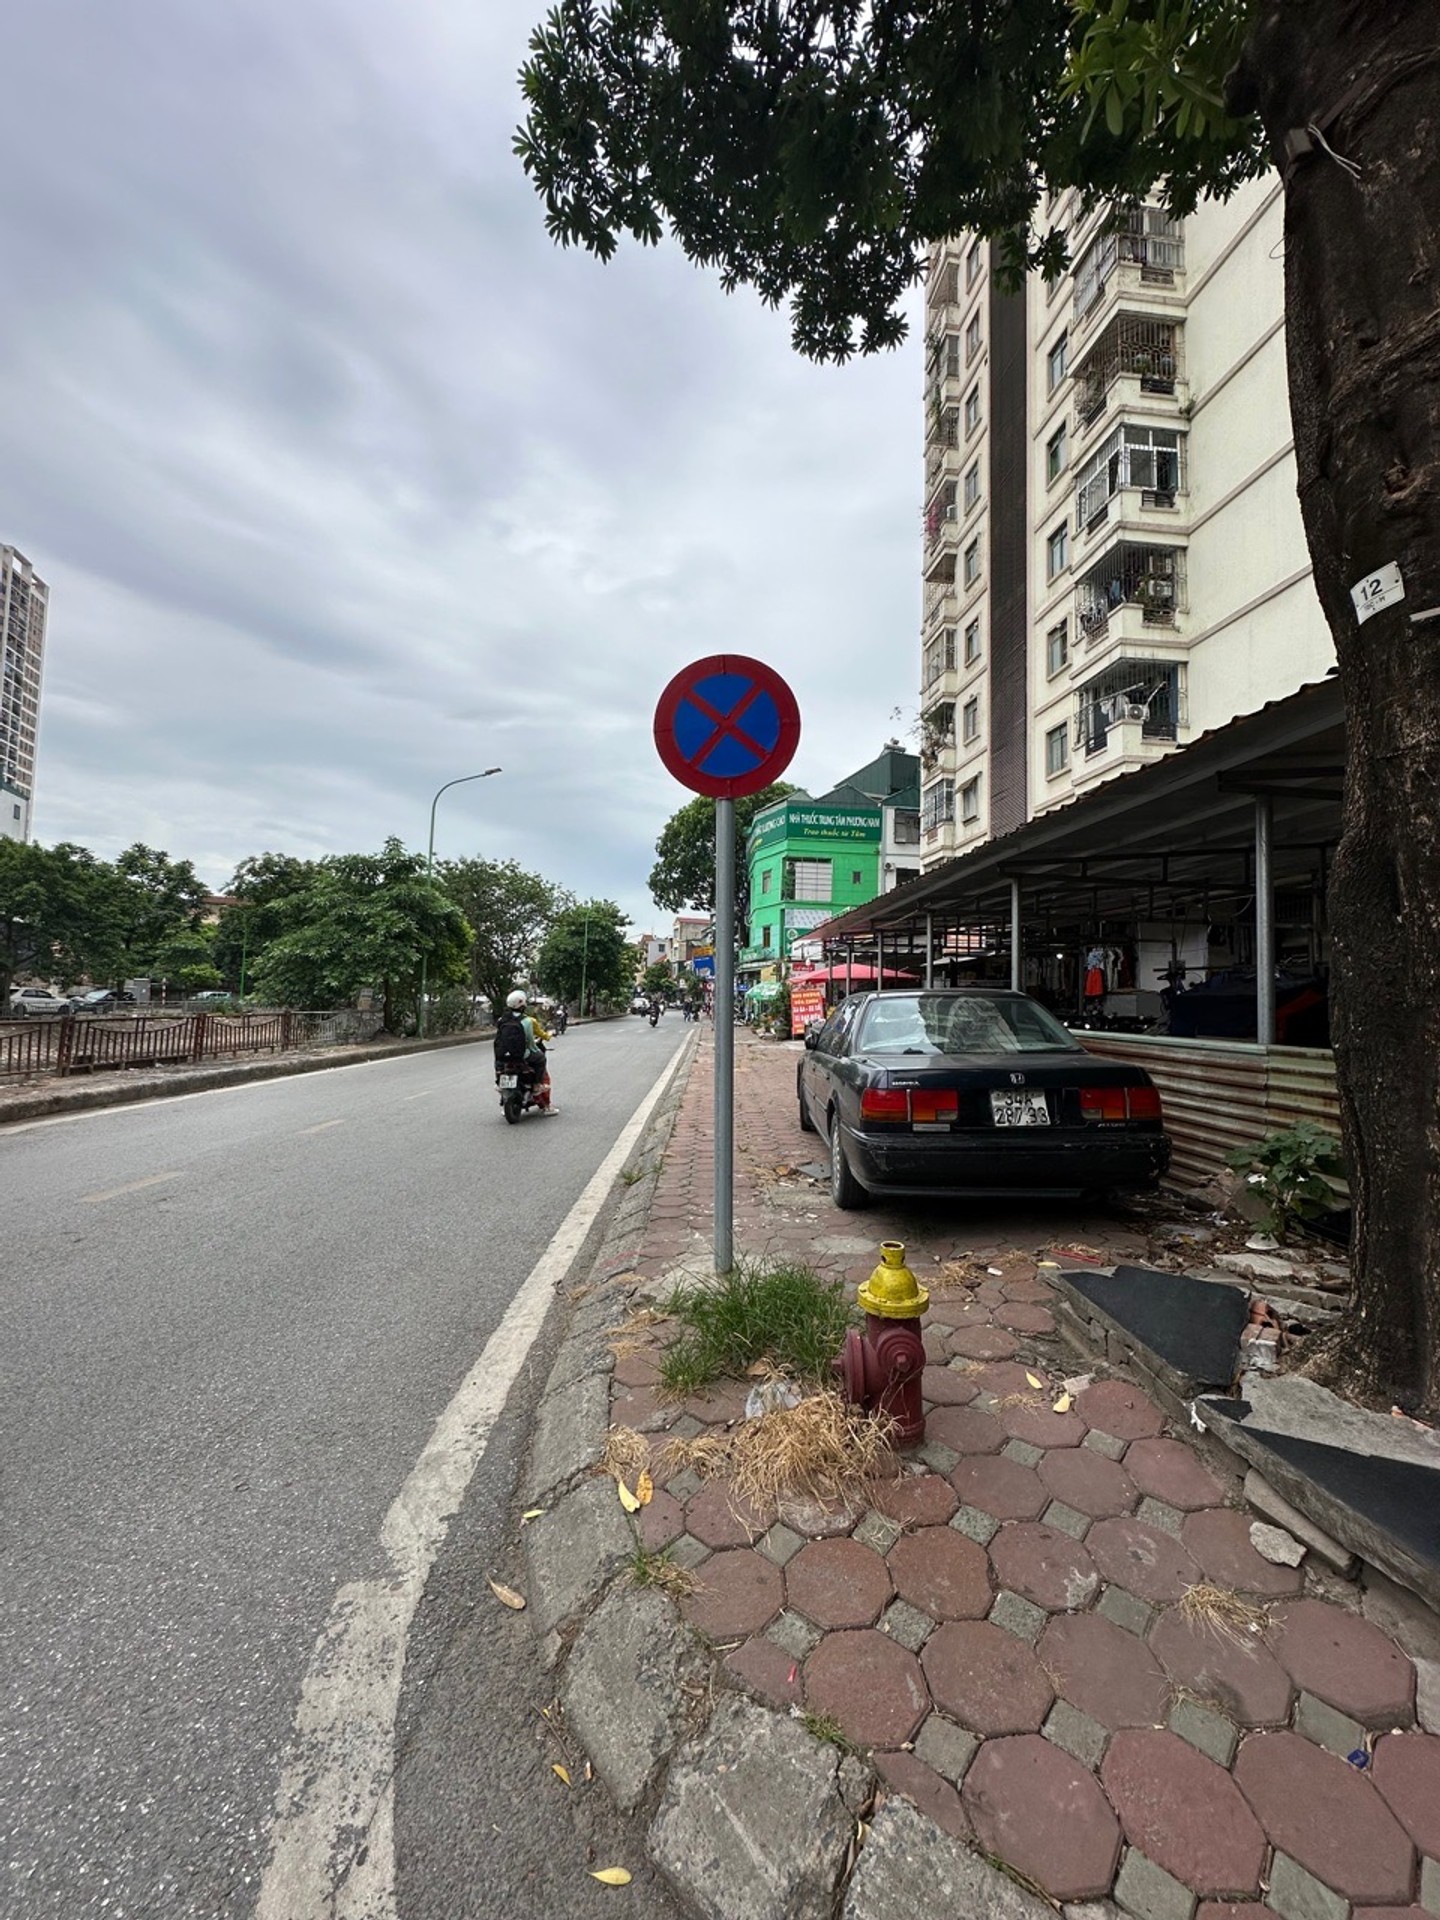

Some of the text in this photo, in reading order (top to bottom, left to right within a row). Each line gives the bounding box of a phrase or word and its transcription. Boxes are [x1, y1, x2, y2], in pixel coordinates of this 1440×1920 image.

[1361, 579, 1383, 601] 12
[789, 812, 800, 824] NHÀ
[801, 810, 819, 826] THUỐC
[995, 1106, 1049, 1125] 287.33
